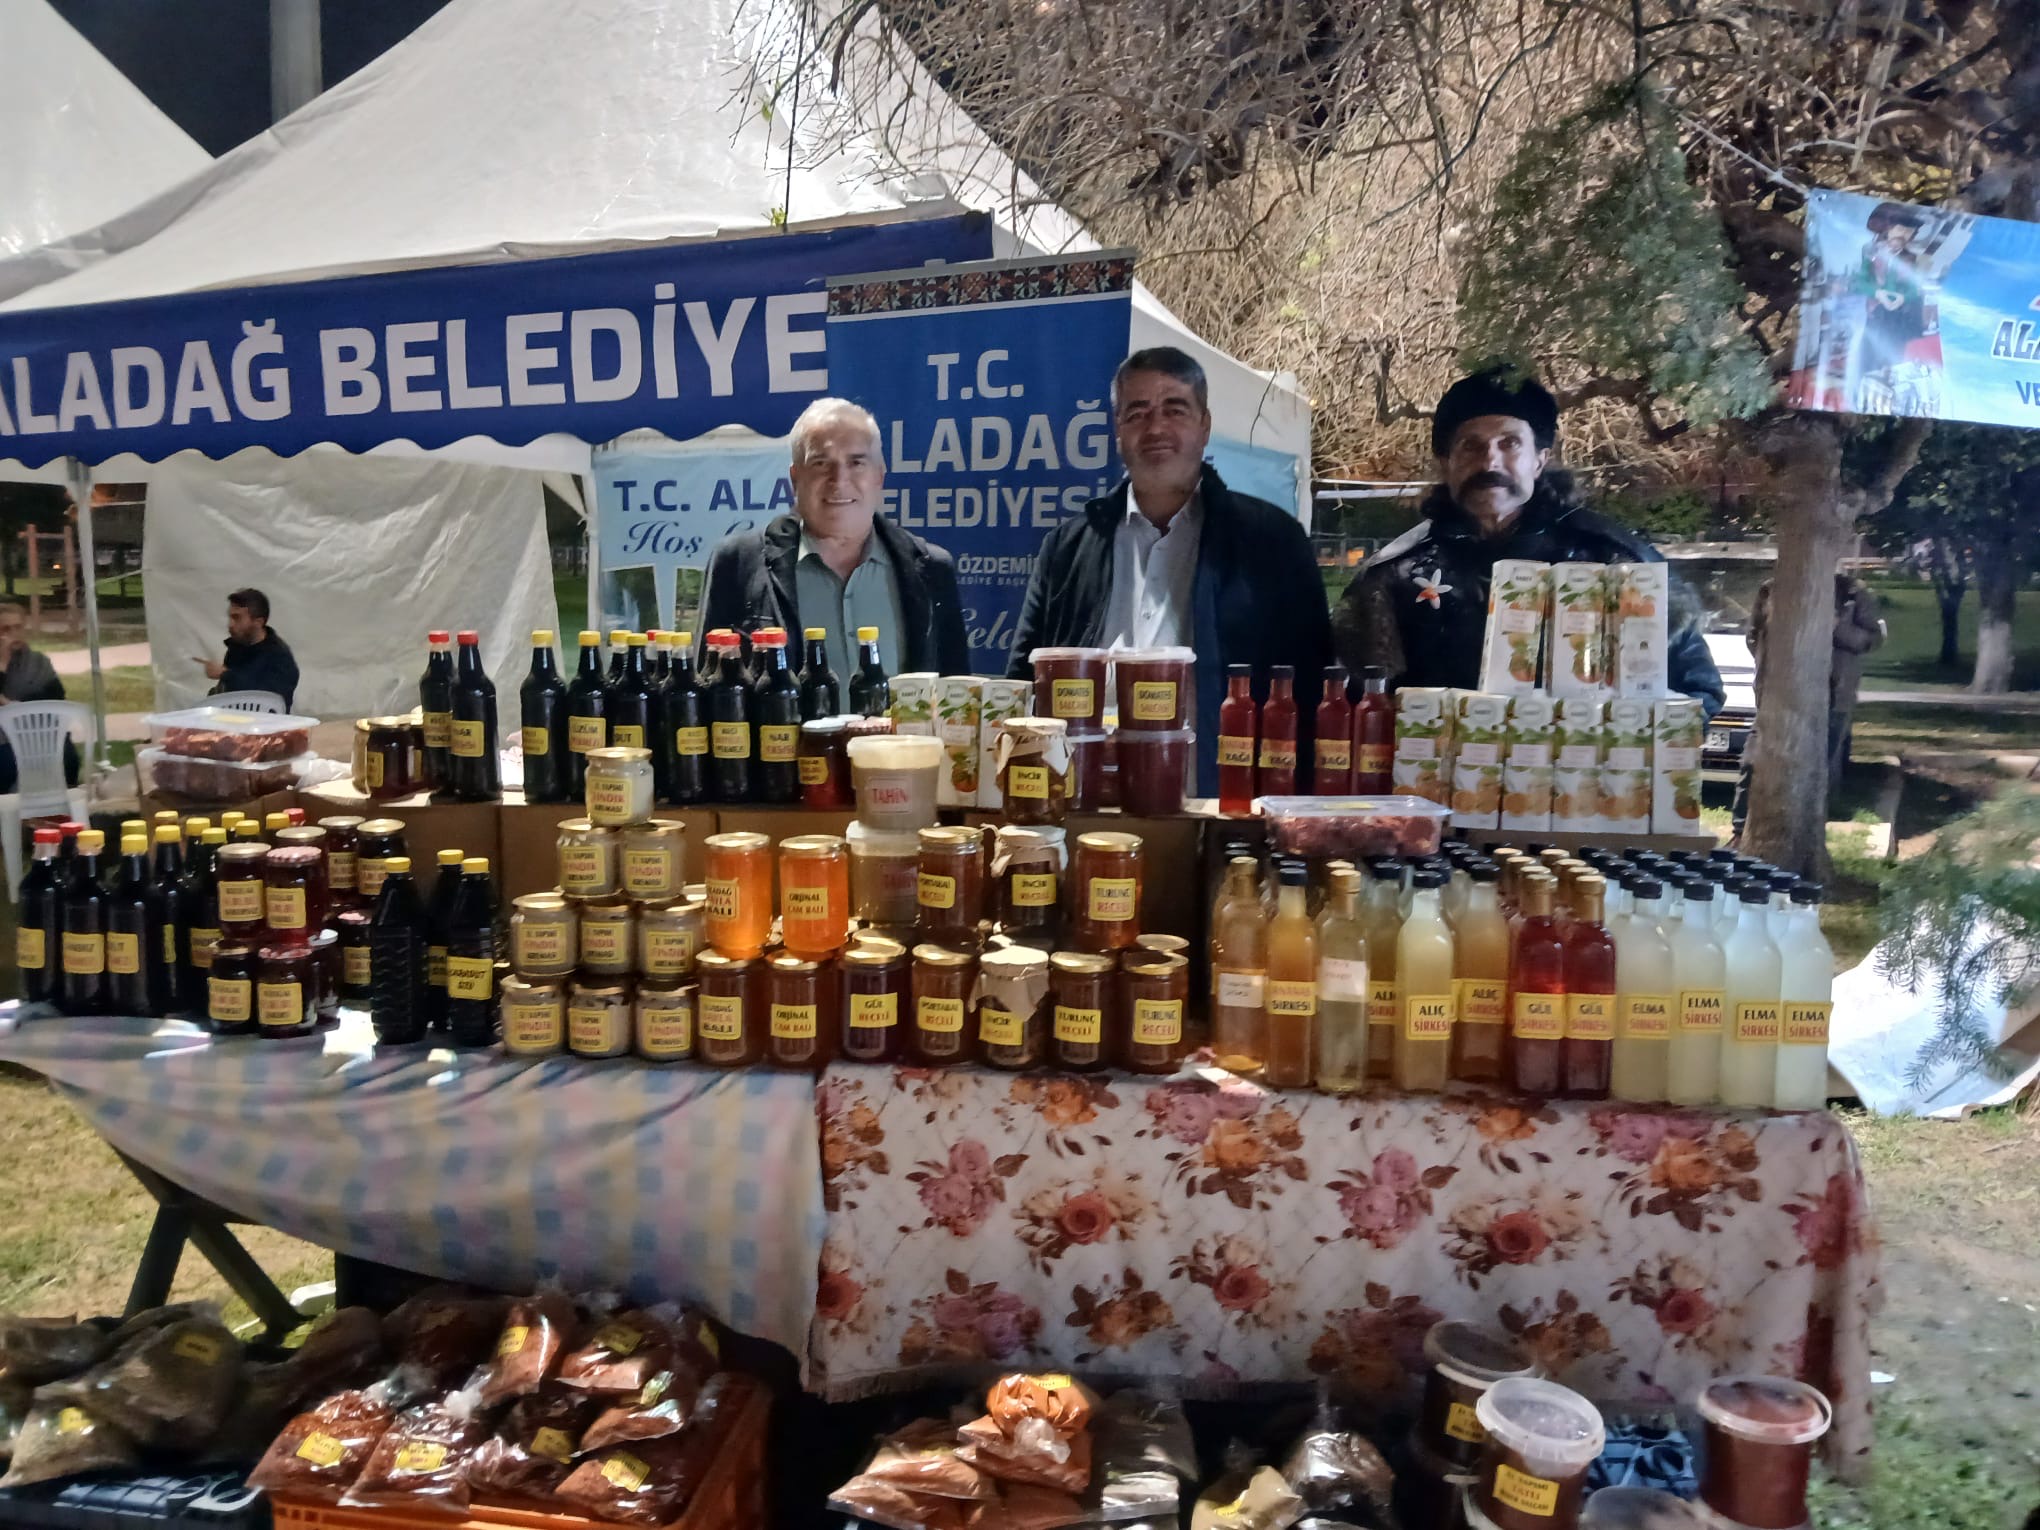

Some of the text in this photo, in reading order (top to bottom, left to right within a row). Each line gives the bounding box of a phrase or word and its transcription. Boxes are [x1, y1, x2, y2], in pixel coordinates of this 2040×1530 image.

[319, 282, 828, 417] BELEDİYE
[1991, 318, 2040, 361] AL
[927, 349, 1024, 401] T.C.
[889, 399, 1109, 473] LADAĞ
[613, 480, 690, 511] T.C.
[879, 478, 1107, 528] ELEDİYES
[624, 520, 702, 558] Hoş
[1418, 1005, 1447, 1019] ALIÇ
[1631, 1002, 1666, 1015] ELMA
[1687, 997, 1721, 1008] ELMA
[1743, 1009, 1777, 1021] ELMA
[1791, 1010, 1826, 1022] ELMA
